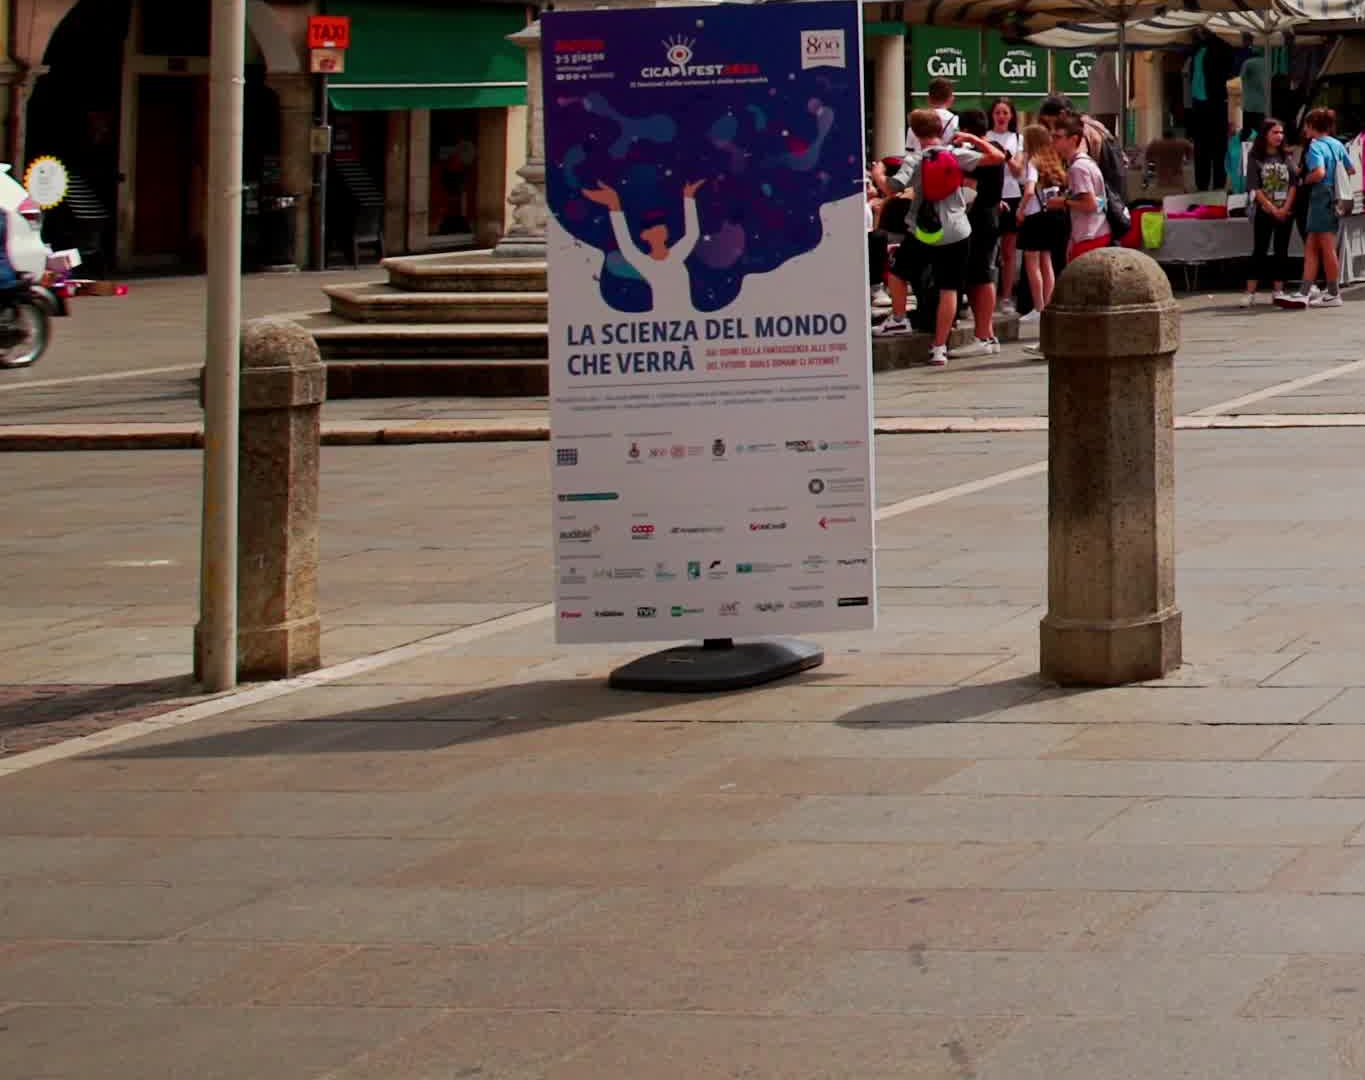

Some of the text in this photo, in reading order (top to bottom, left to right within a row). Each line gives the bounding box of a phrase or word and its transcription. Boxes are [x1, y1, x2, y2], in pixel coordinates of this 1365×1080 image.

[311, 23, 346, 41] TAXI
[927, 55, 967, 77] Carli
[999, 57, 1037, 78] Carli
[568, 312, 848, 346] LA SCIENZA DEL MONDO
[567, 345, 694, 376] CHE VERRÀ
